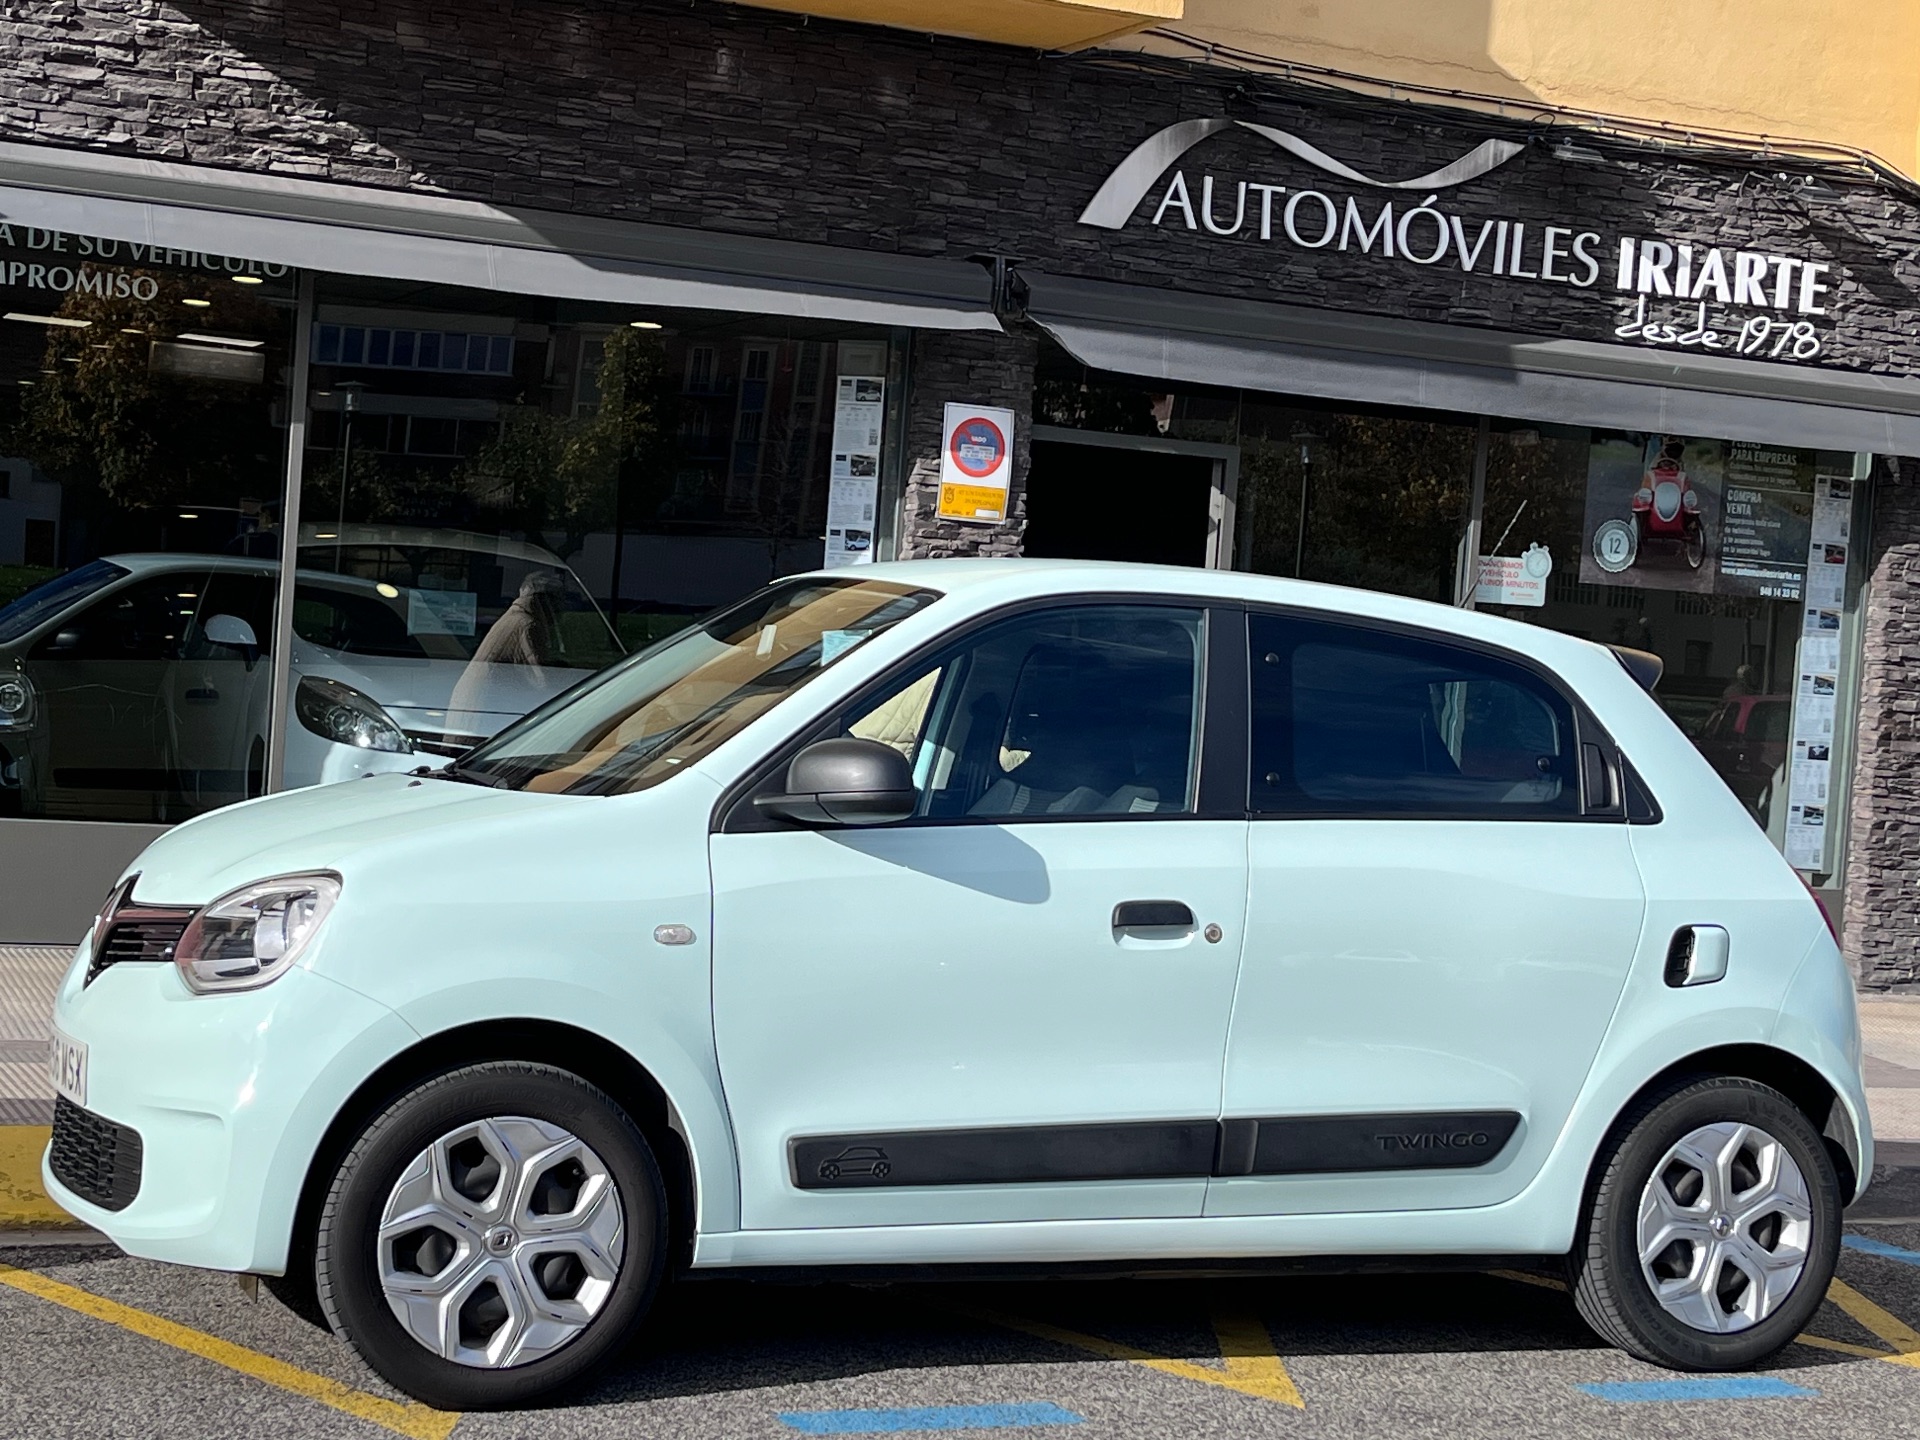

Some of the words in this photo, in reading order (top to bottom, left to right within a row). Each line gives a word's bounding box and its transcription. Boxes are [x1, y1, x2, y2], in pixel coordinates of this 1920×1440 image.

[27, 227, 68, 252] DE
[78, 235, 118, 258] SU
[1152, 170, 1600, 287] AUTOMÓVILES
[1616, 237, 1829, 316] IRIARTE
[0, 260, 159, 301] PROMISO
[1615, 292, 1721, 349] desde
[1737, 317, 1820, 360] 1978
[1729, 449, 1753, 461] PARA
[1754, 451, 1797, 465] EMPRESAS
[1727, 489, 1762, 503] COMPRA
[1726, 502, 1752, 516] VENTA
[1609, 537, 1621, 554] 12
[1375, 1132, 1489, 1150] TWINGO
